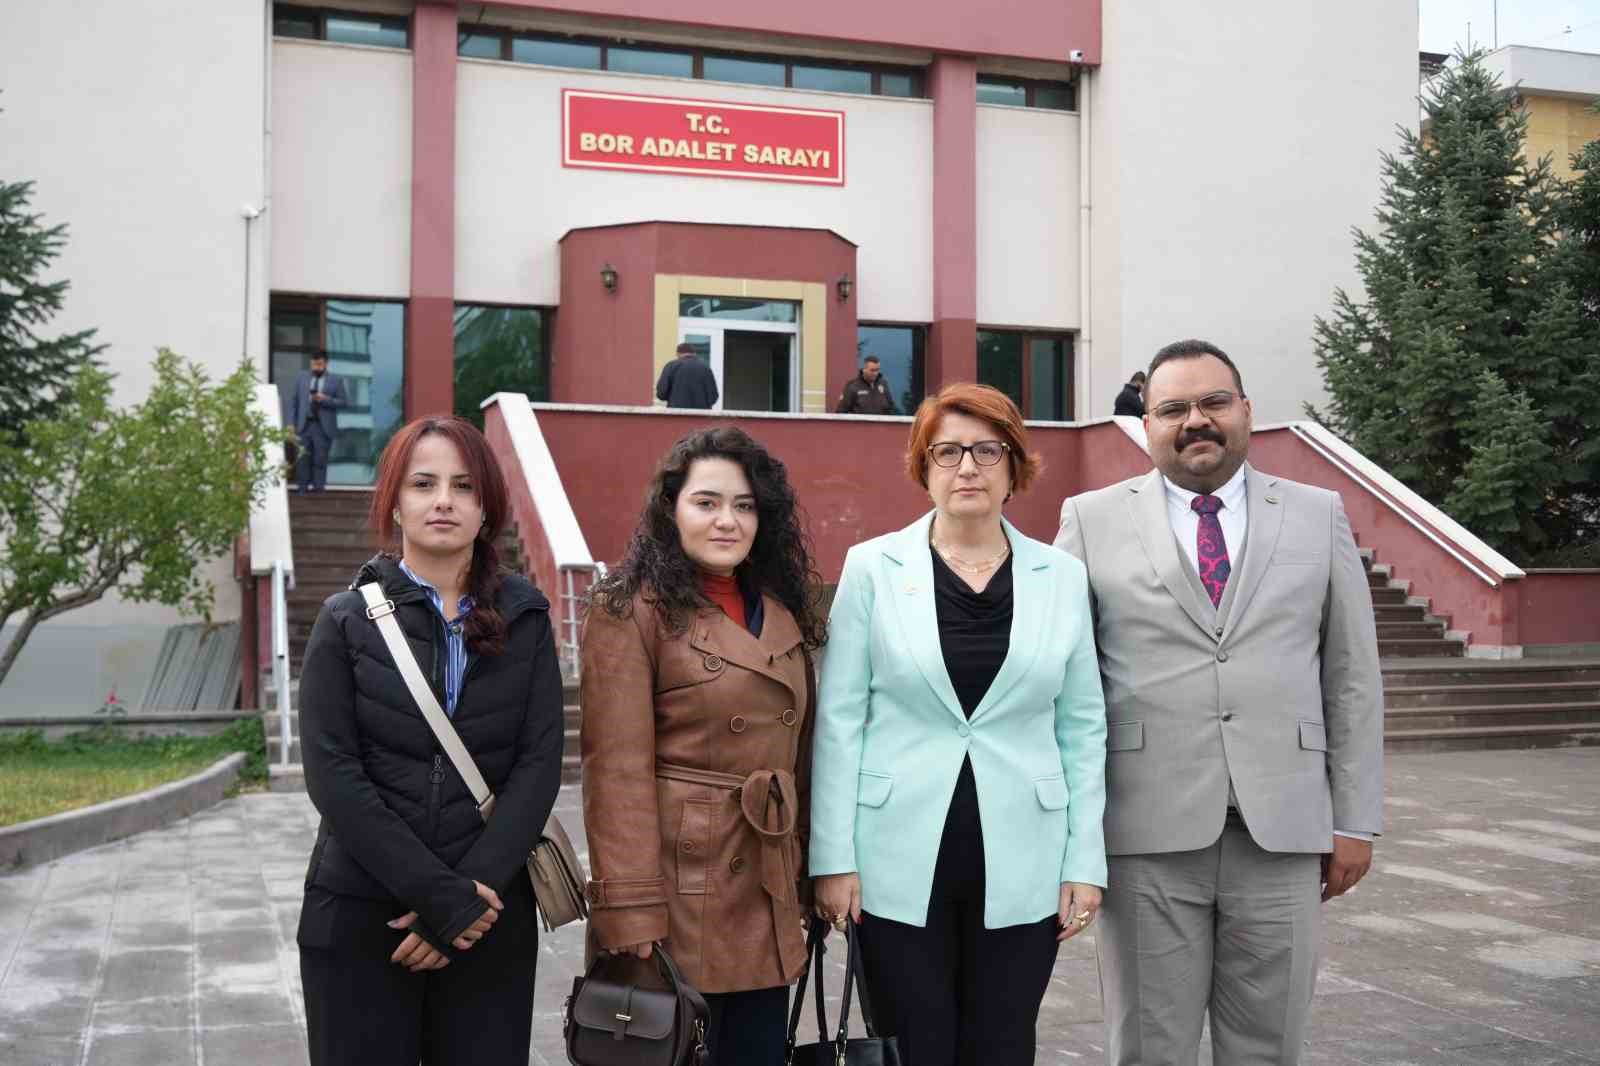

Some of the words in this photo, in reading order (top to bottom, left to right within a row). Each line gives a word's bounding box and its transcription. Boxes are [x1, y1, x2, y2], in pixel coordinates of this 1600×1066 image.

[686, 112, 731, 134] T.C.
[579, 132, 634, 155] BOR
[640, 137, 737, 162] ADALET
[743, 144, 831, 169] SARAYI
